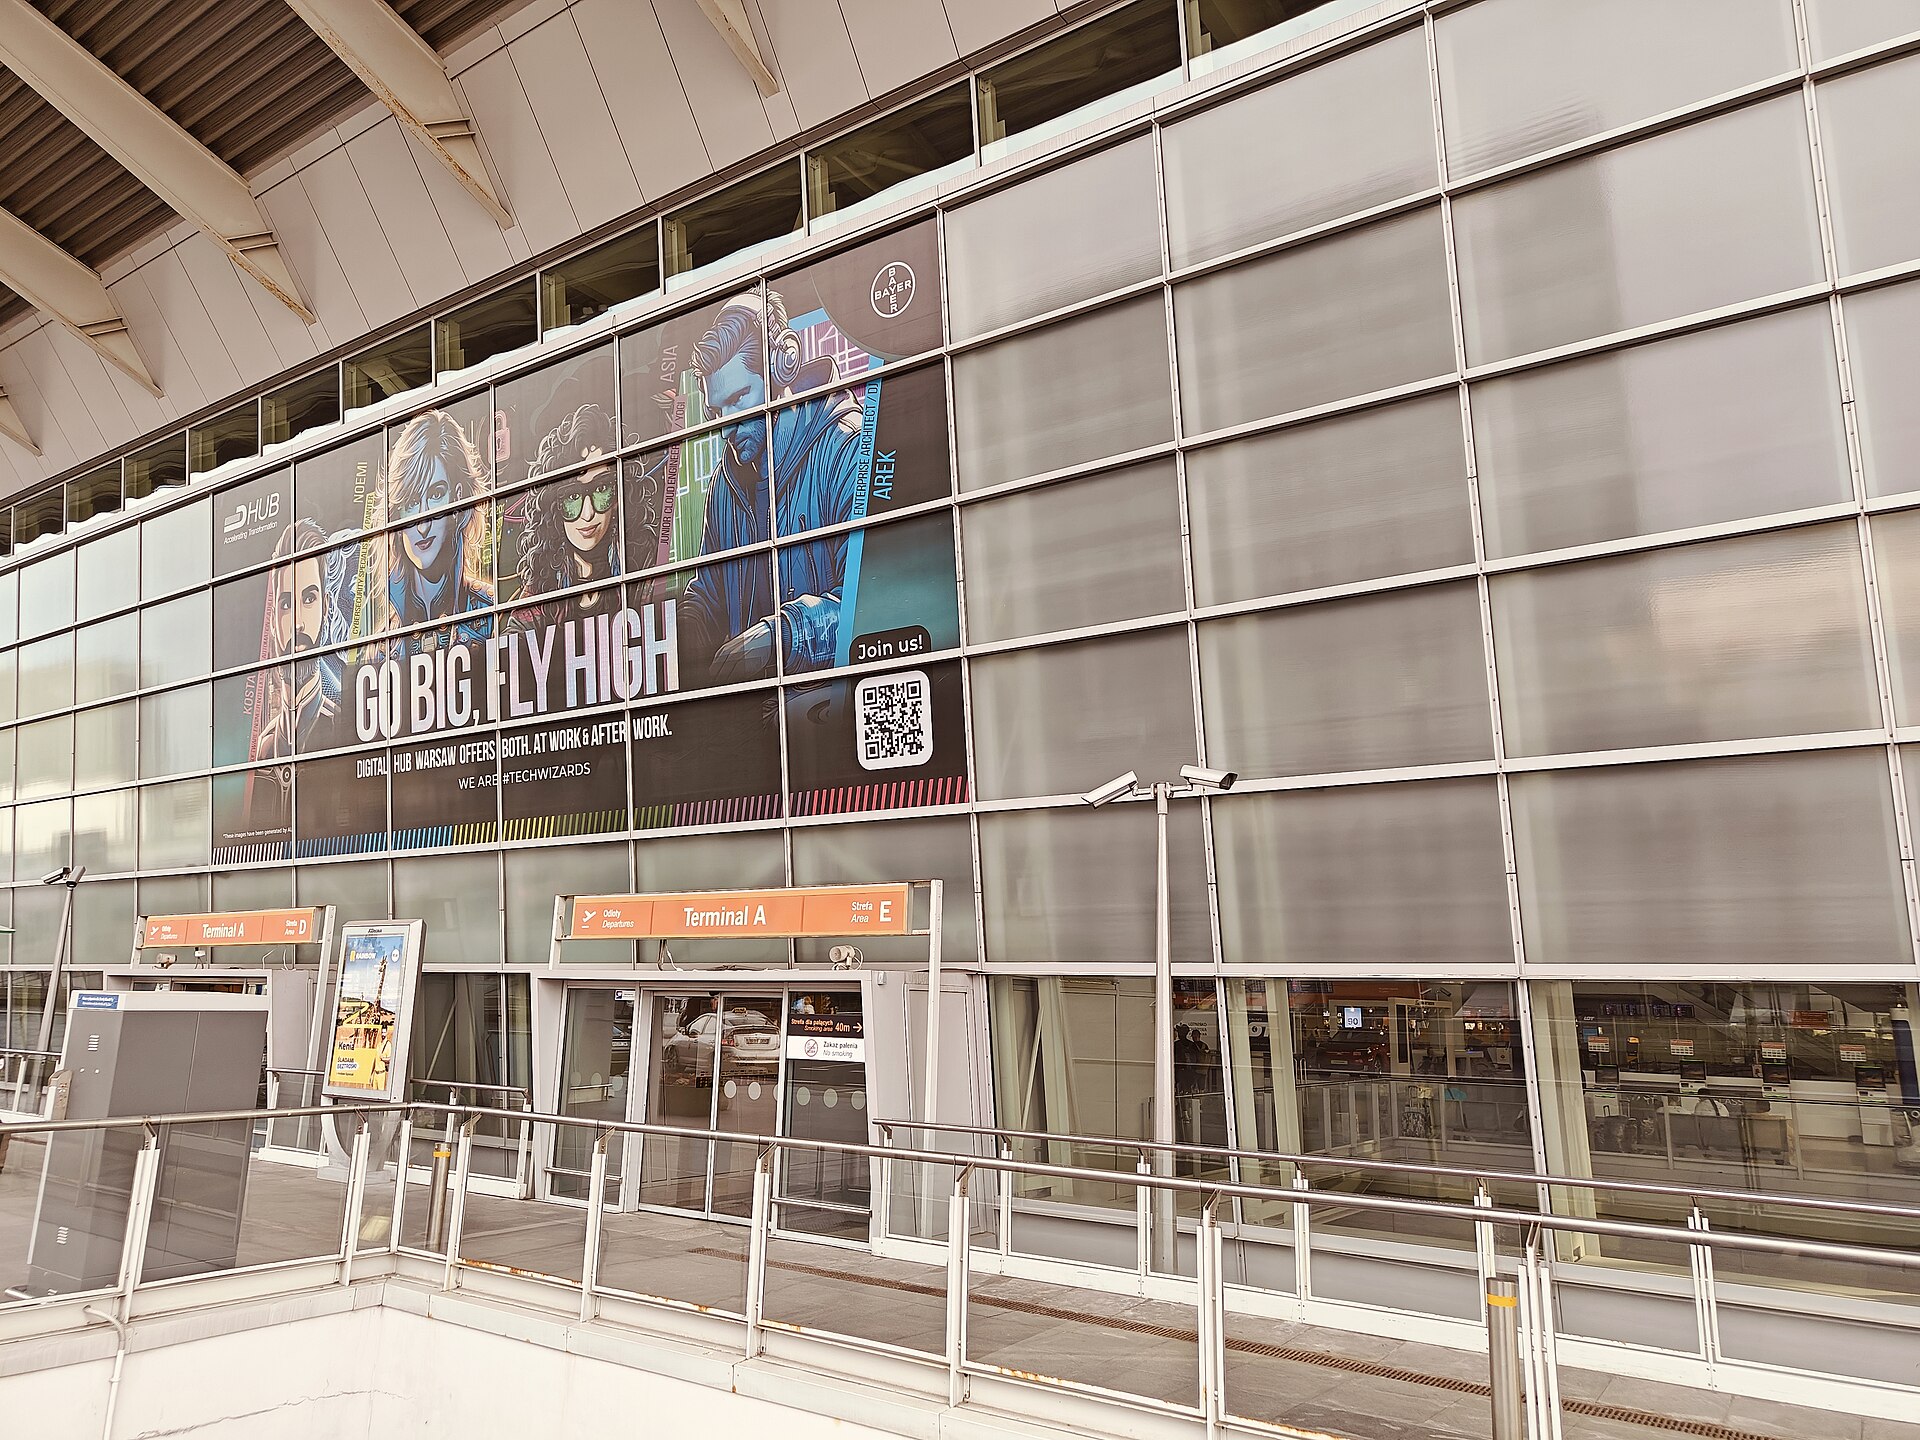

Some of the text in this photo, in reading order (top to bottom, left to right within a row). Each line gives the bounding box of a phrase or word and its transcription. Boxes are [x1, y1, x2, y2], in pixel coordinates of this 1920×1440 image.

[875, 279, 912, 301] BAYER
[888, 266, 898, 314] BAYER
[660, 344, 678, 382] ASIA
[867, 382, 879, 394] DJ
[675, 401, 686, 421] YOGI
[861, 404, 876, 457] ARCHITECT
[668, 444, 680, 485] ENGINEER
[873, 449, 897, 500] AREK
[353, 461, 368, 504] NOEMI
[853, 458, 870, 516] ENTERPRISE
[664, 486, 676, 514] CLOUD
[660, 516, 673, 545] JUNIOR
[352, 579, 364, 635] CYBERSECURITY
[364, 494, 375, 524] PAINTER
[858, 634, 923, 660] Join us!
[355, 598, 680, 742] GO BIG, FLY HIGH
[243, 674, 257, 715] KOSTA
[356, 713, 673, 779] DIGITAL HUB WARSAW OFFERS BOTH. AT WORK & AFTER WORK.
[458, 762, 591, 790] WE ARE #TECHWIZARDS
[601, 909, 634, 930] Odloty Departures
[683, 904, 767, 927] Terminal A
[850, 913, 869, 923] Area
[851, 900, 892, 922] Strefa E
[202, 922, 245, 938] Terminal A
[298, 919, 307, 935] D
[835, 1022, 850, 1033] 40m
[338, 1041, 355, 1051] Kenia
[831, 1051, 853, 1059] smoking
[839, 1042, 858, 1050] palenia
